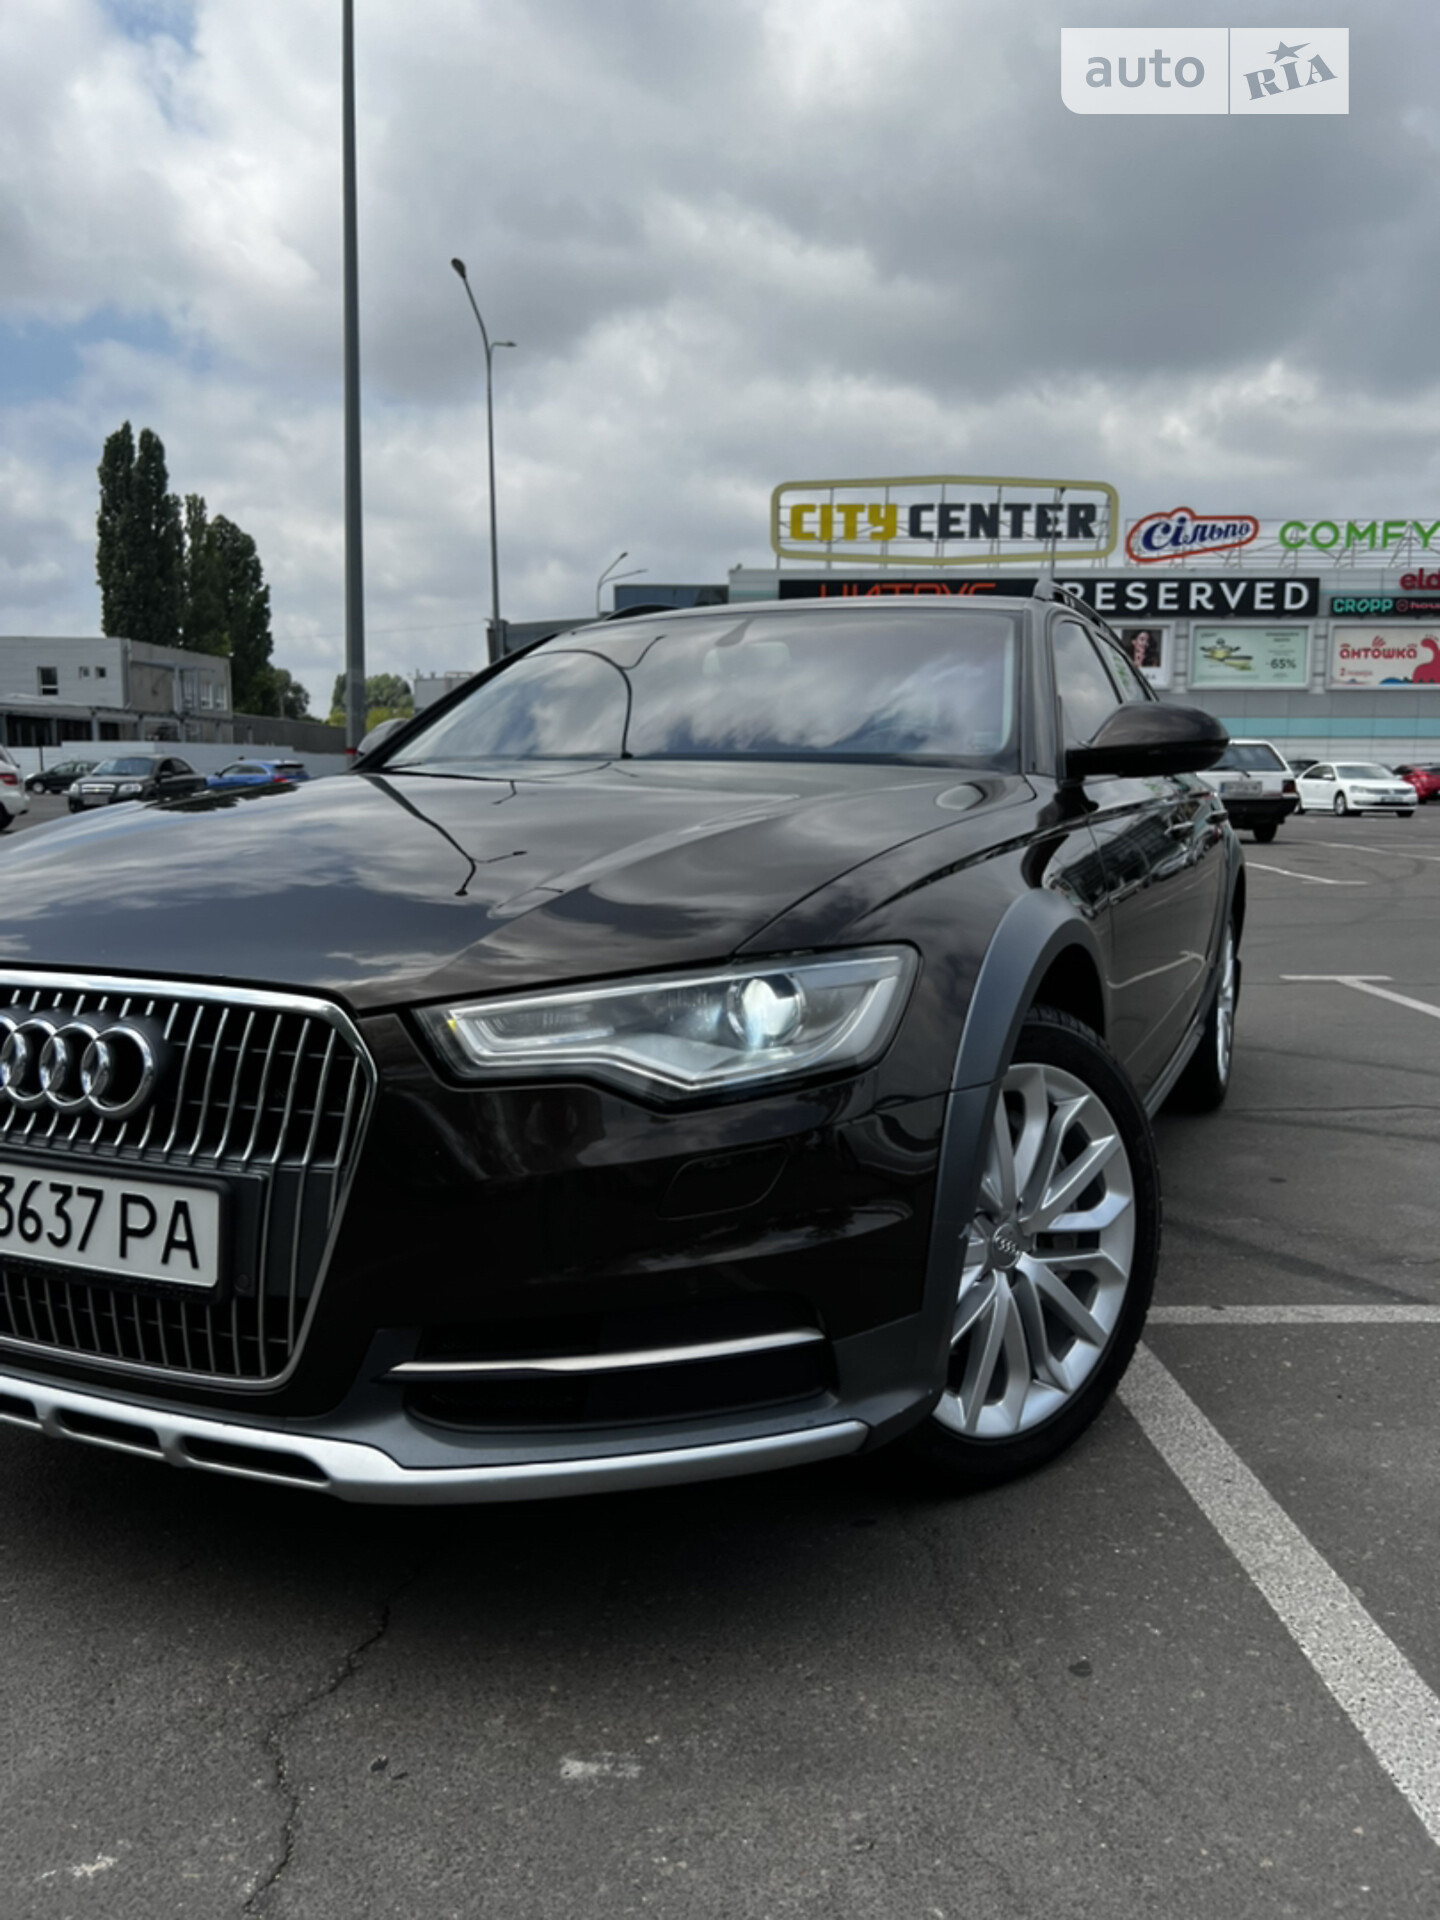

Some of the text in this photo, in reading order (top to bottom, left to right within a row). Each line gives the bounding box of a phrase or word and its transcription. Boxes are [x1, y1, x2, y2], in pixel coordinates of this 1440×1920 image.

[789, 503, 1097, 542] CITY CENTER
[1279, 520, 1440, 549] COMFY
[1333, 598, 1393, 613] CROPP
[0, 1174, 200, 1270] 3637 PA
